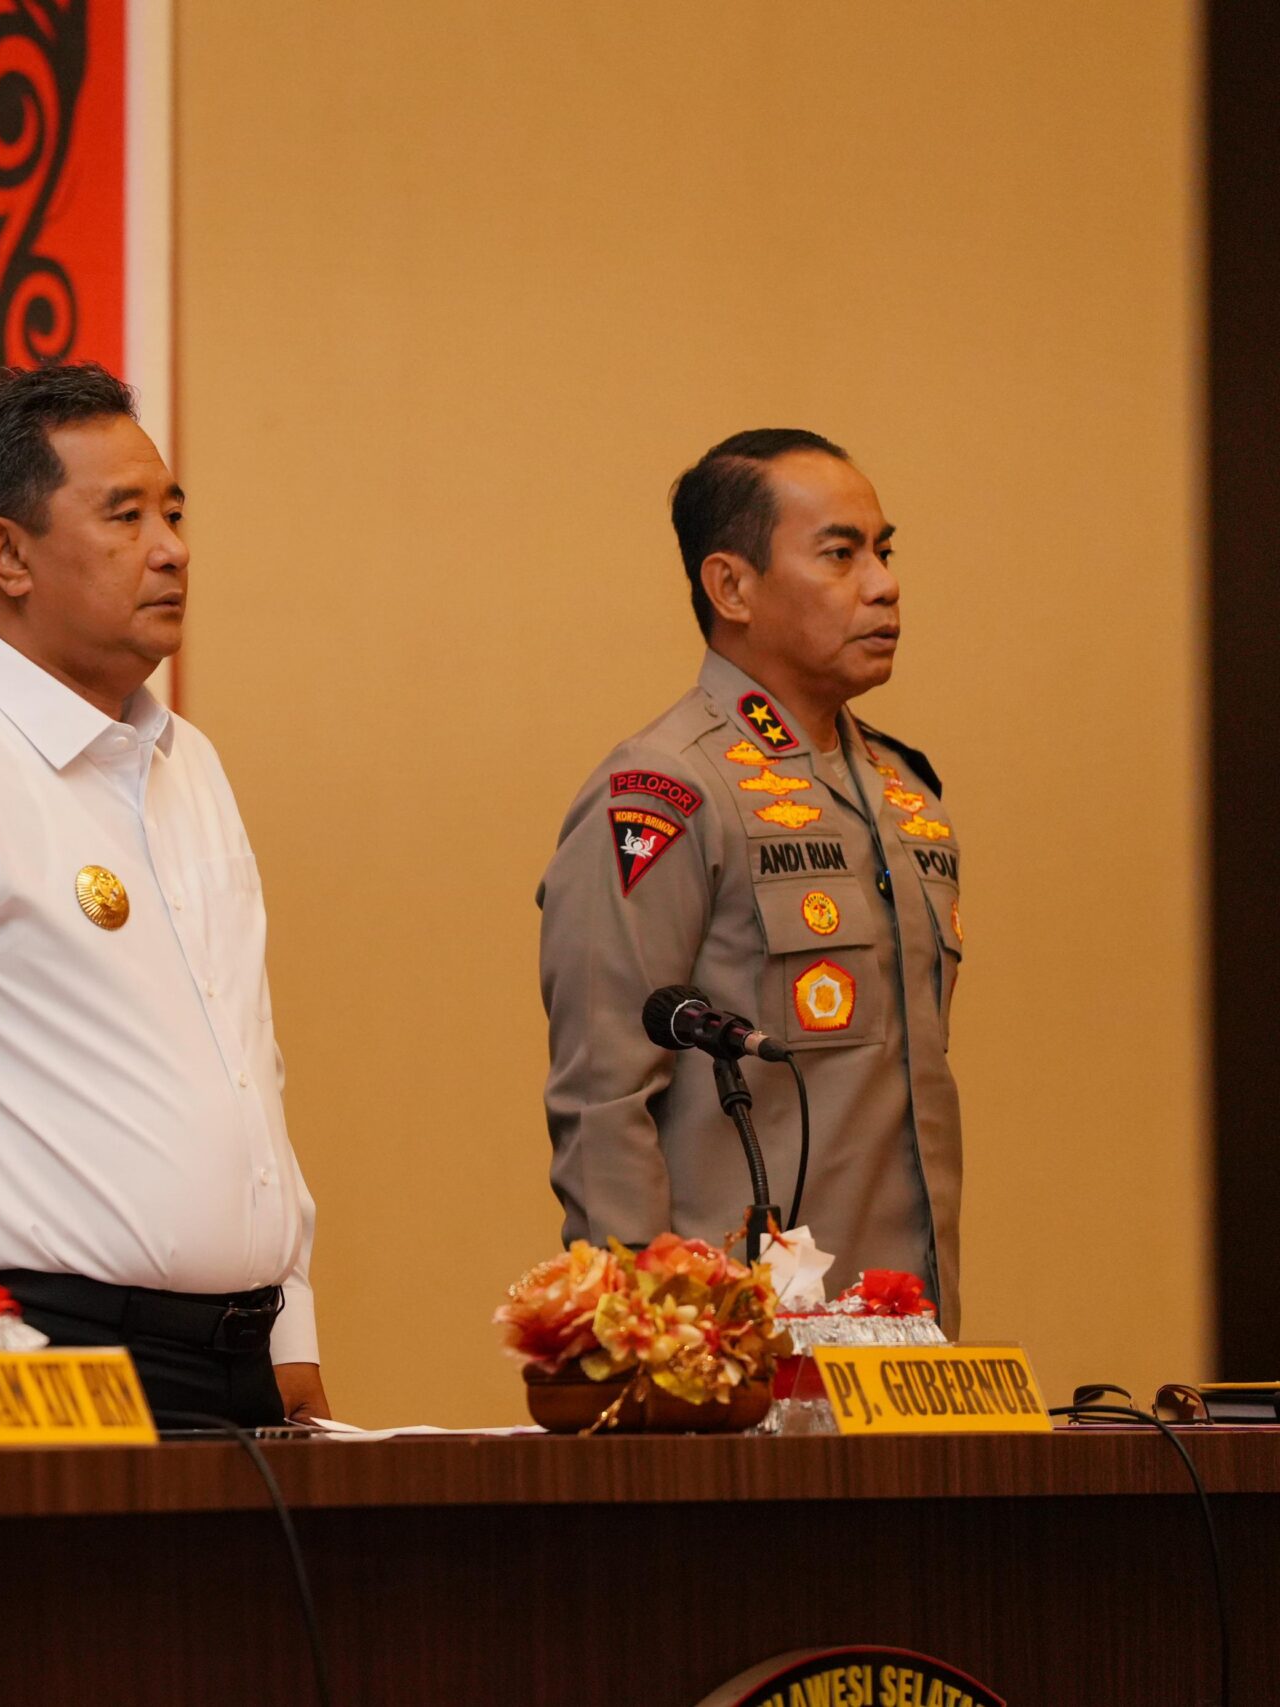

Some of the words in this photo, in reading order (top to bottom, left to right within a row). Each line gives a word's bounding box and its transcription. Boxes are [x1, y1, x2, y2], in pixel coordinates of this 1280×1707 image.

[617, 775, 692, 808] PELOPOR
[614, 811, 643, 823] KORPS
[645, 815, 677, 836] BRIMOB
[761, 843, 807, 875] ANDI
[805, 842, 848, 870] RIAN
[825, 1361, 882, 1425] PJ.
[880, 1359, 1040, 1416] GUBERNUR
[879, 1665, 985, 1707] SELAT
